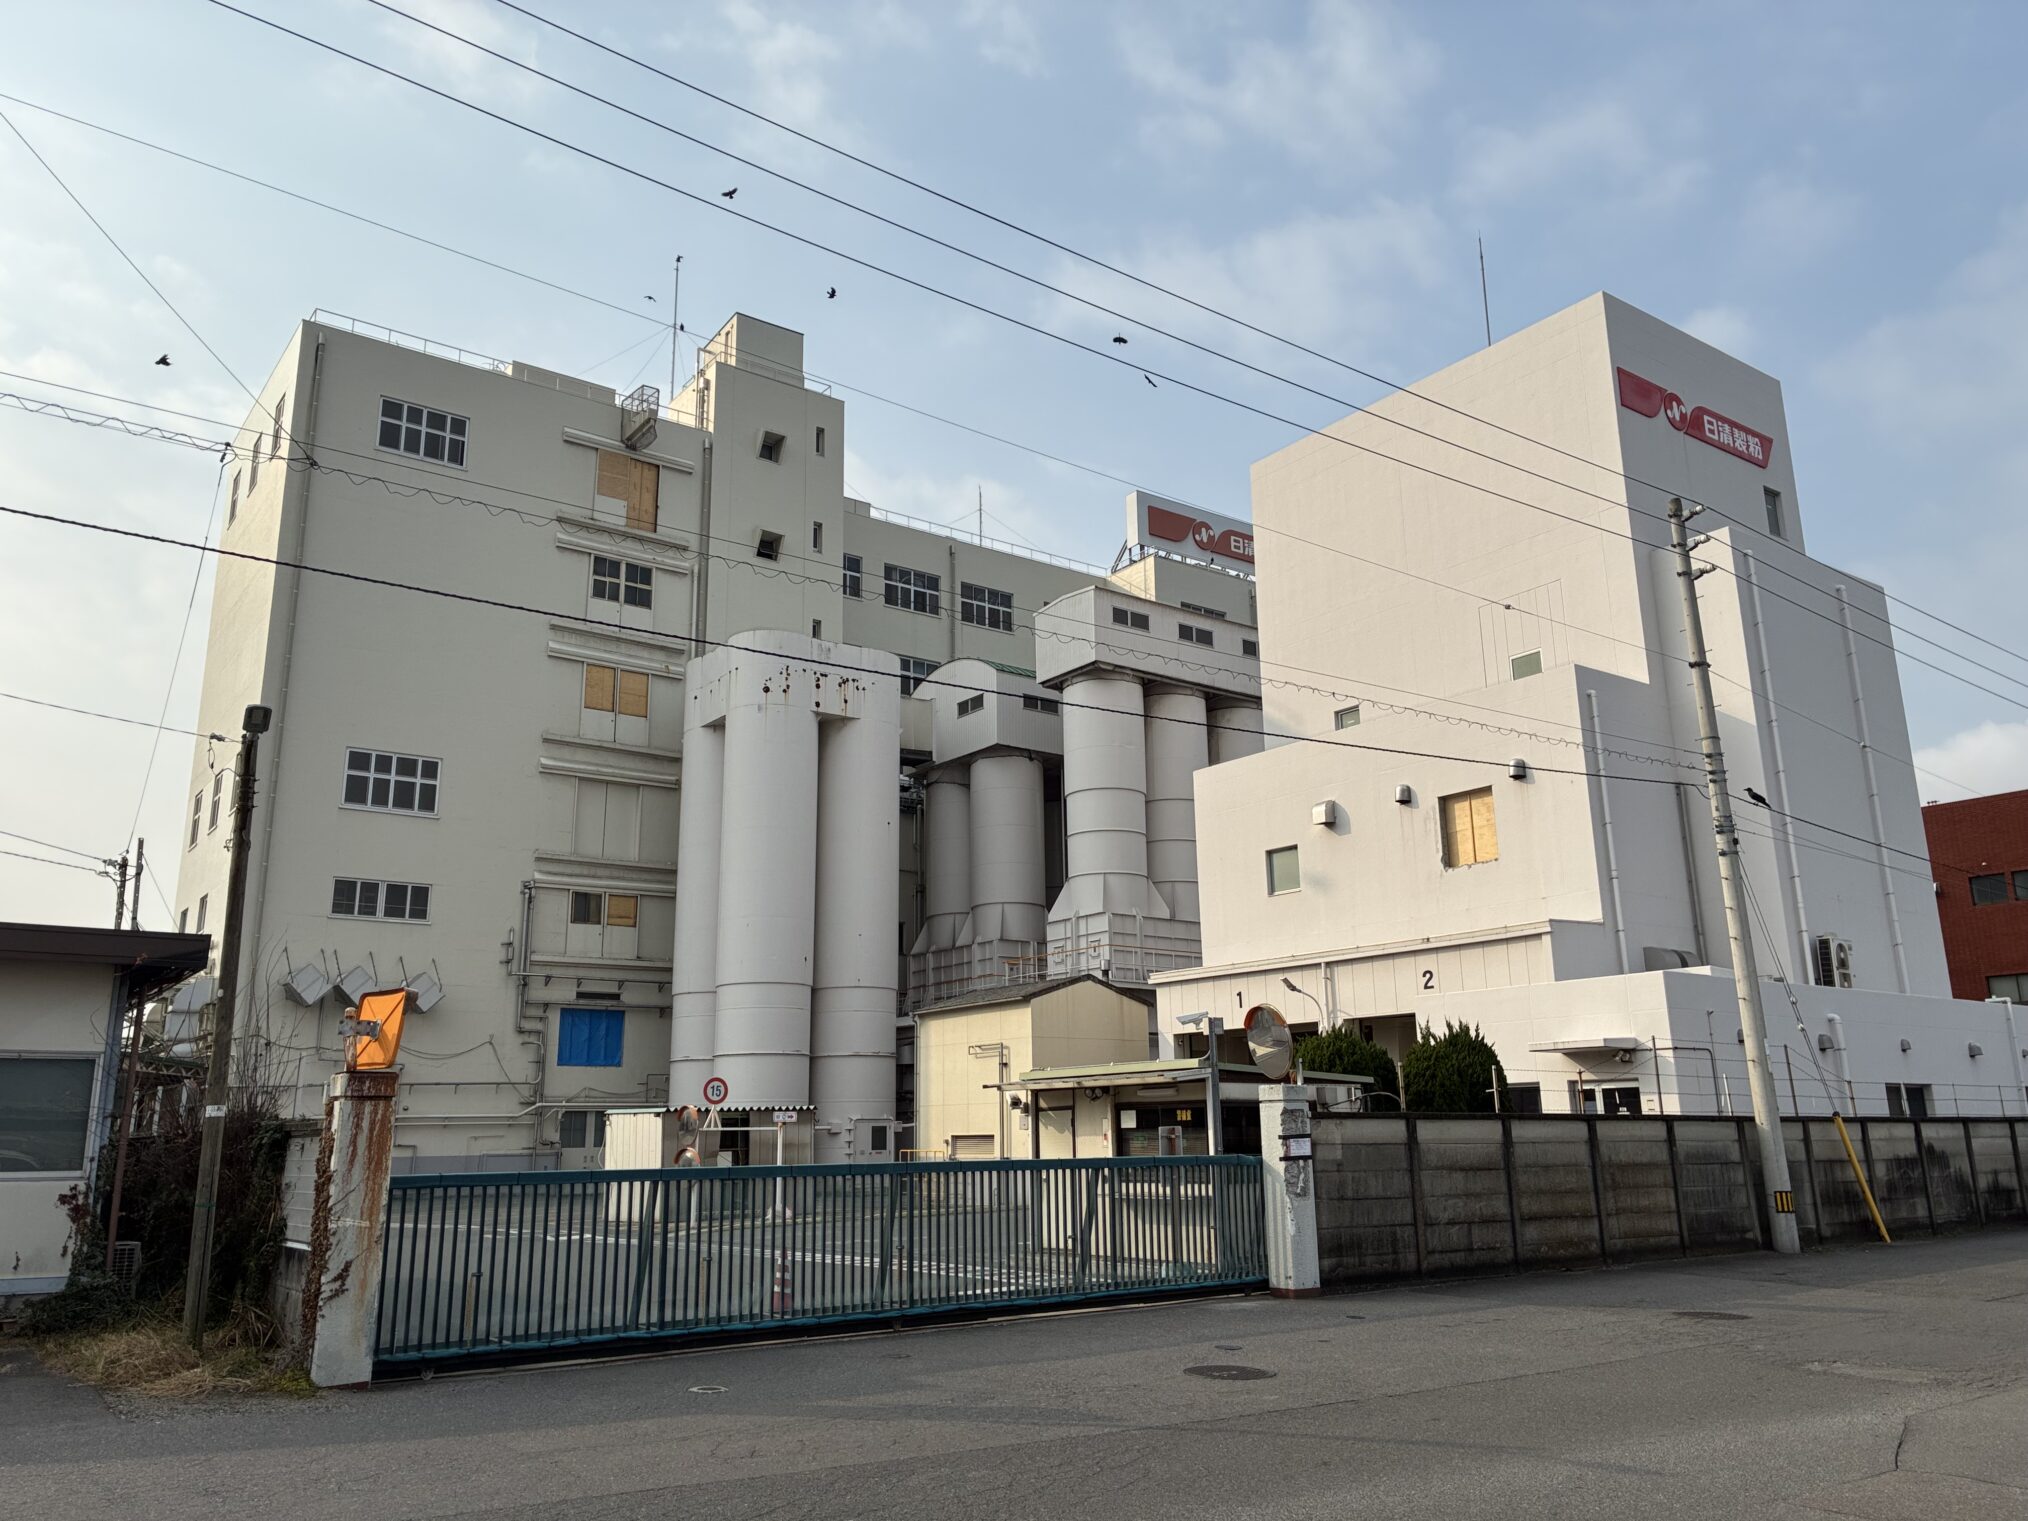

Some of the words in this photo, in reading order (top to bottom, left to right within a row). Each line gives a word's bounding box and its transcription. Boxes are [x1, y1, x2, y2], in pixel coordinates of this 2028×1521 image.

[1703, 414, 1763, 460] 日清製粉
[1422, 970, 1435, 990] 2
[1236, 991, 1243, 1008] 1
[710, 1084, 722, 1098] 15
